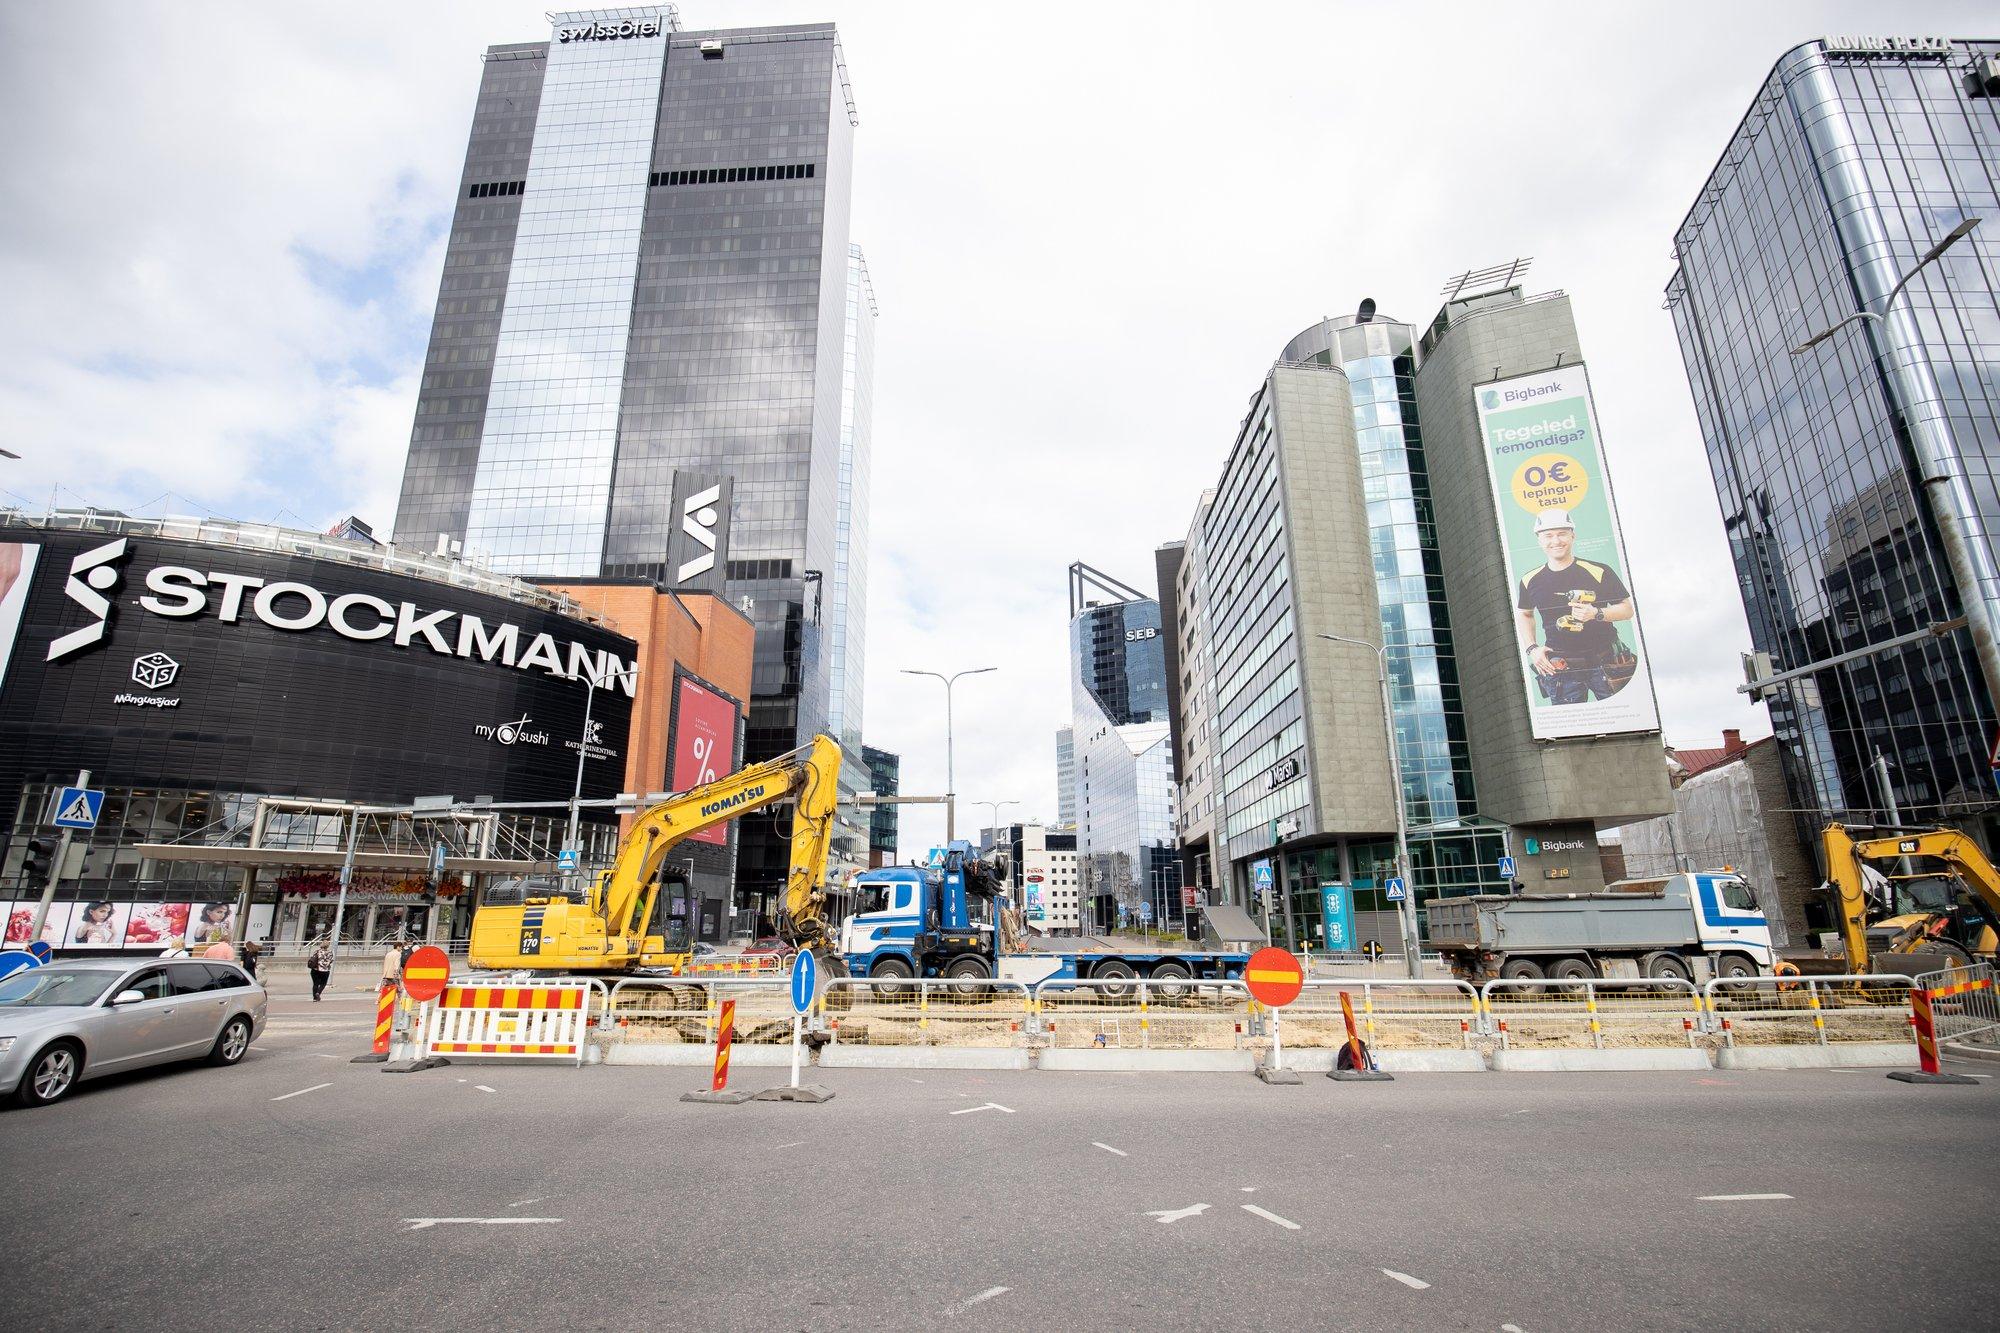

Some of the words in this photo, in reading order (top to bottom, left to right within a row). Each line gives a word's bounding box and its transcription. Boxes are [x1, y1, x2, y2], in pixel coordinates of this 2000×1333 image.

[1824, 34, 1891, 50] NOVIRA
[1894, 34, 1955, 50] PLAZA
[1504, 382, 1562, 402] Bigbank
[1492, 414, 1577, 442] Tegeled
[1495, 429, 1586, 455] remondiga?
[1523, 484, 1579, 499] lepingu-
[1538, 495, 1568, 508] tasu
[139, 565, 639, 698] STOCKMANN
[1126, 627, 1156, 641] SEB
[113, 693, 180, 708] Mänguasjad
[475, 724, 496, 741] my
[519, 730, 549, 746] sushi
[565, 741, 617, 757] KATHRINENTHAL
[1273, 759, 1294, 786] Marsh
[701, 785, 765, 818] KOMATSU
[1542, 840, 1585, 852] Bigbank
[1900, 842, 1915, 852] CAT
[522, 938, 538, 948] 170
[523, 931, 533, 939] PC
